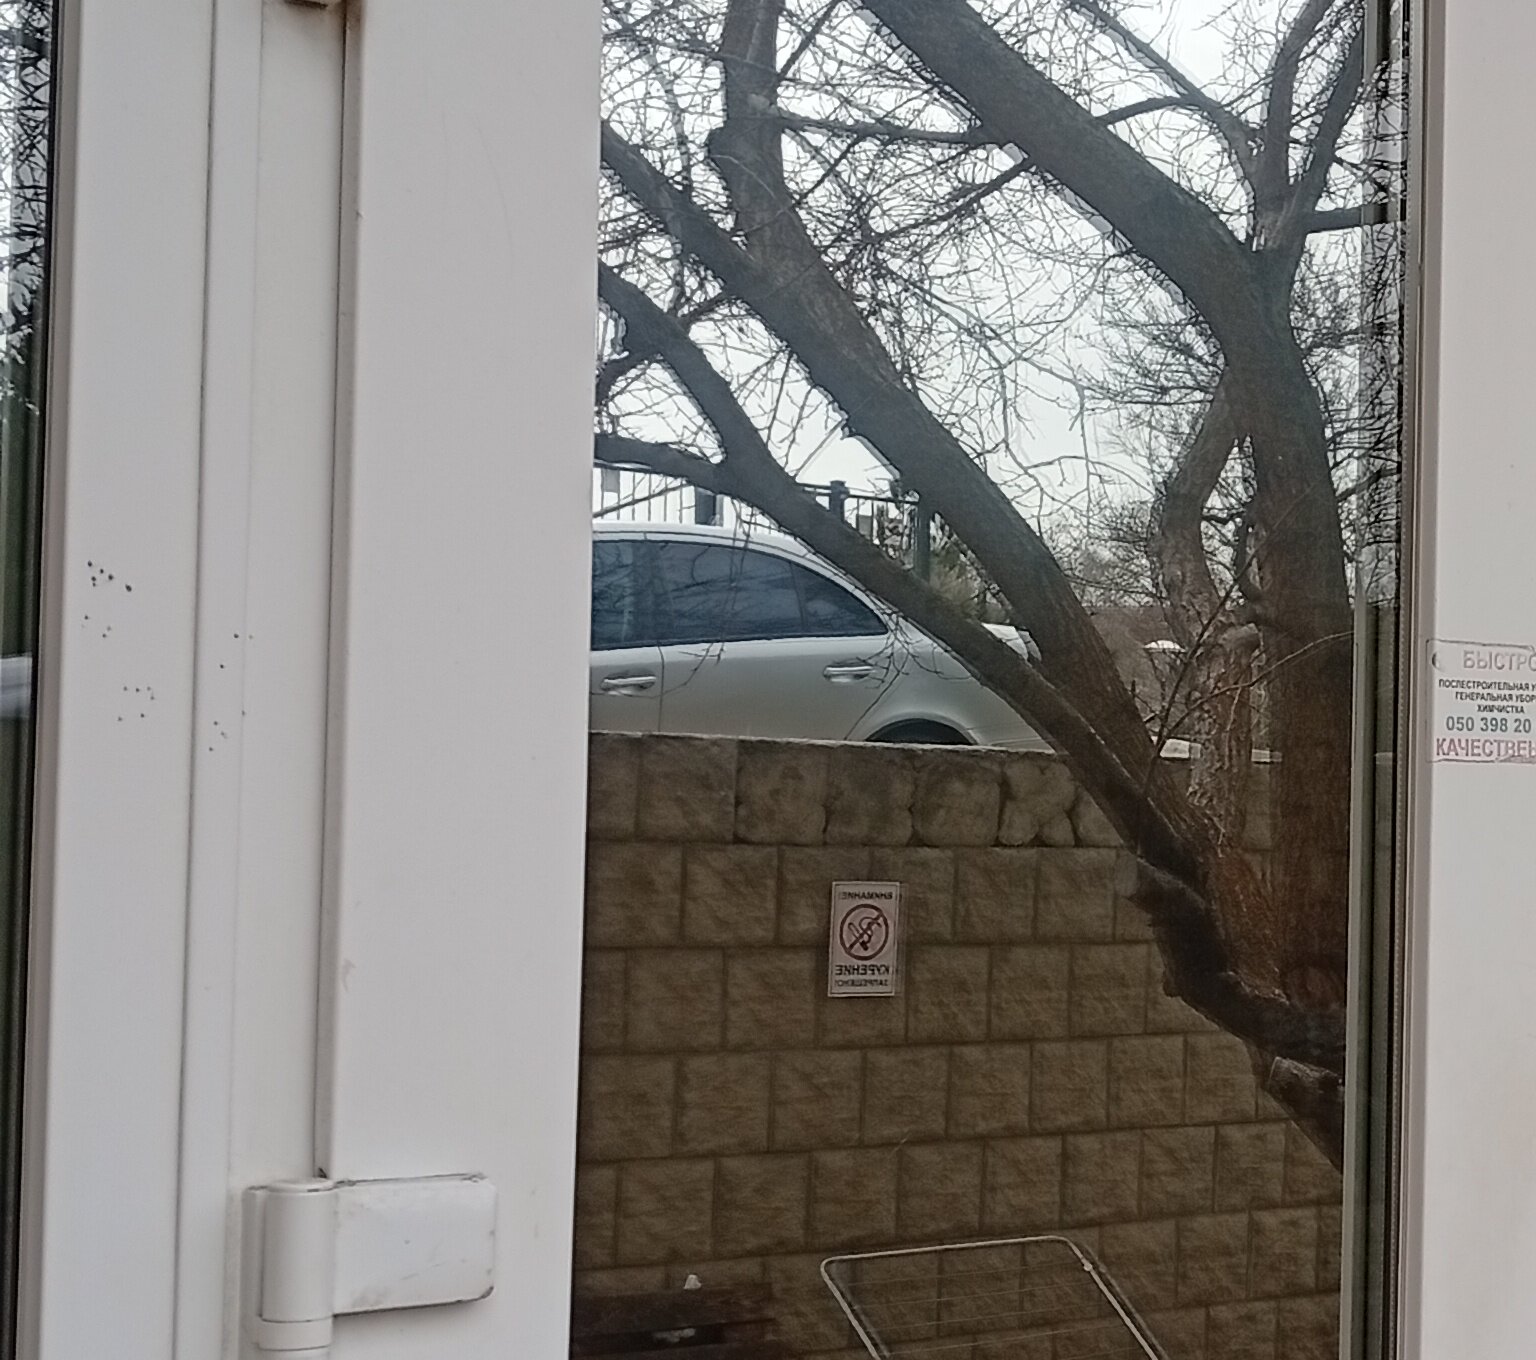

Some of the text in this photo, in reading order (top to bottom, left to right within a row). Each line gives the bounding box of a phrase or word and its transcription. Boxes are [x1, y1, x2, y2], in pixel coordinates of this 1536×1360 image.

[1438, 678, 1530, 691] ПОСЛЕСТРОИТЕЛЬНАЯ
[1455, 691, 1513, 702] ГЕНЕРАЛЬНАЯ
[1477, 704, 1525, 714] ХИМЧИСТКА
[1446, 715, 1475, 732] 050
[1480, 717, 1508, 733] 398
[1513, 718, 1532, 734] 20
